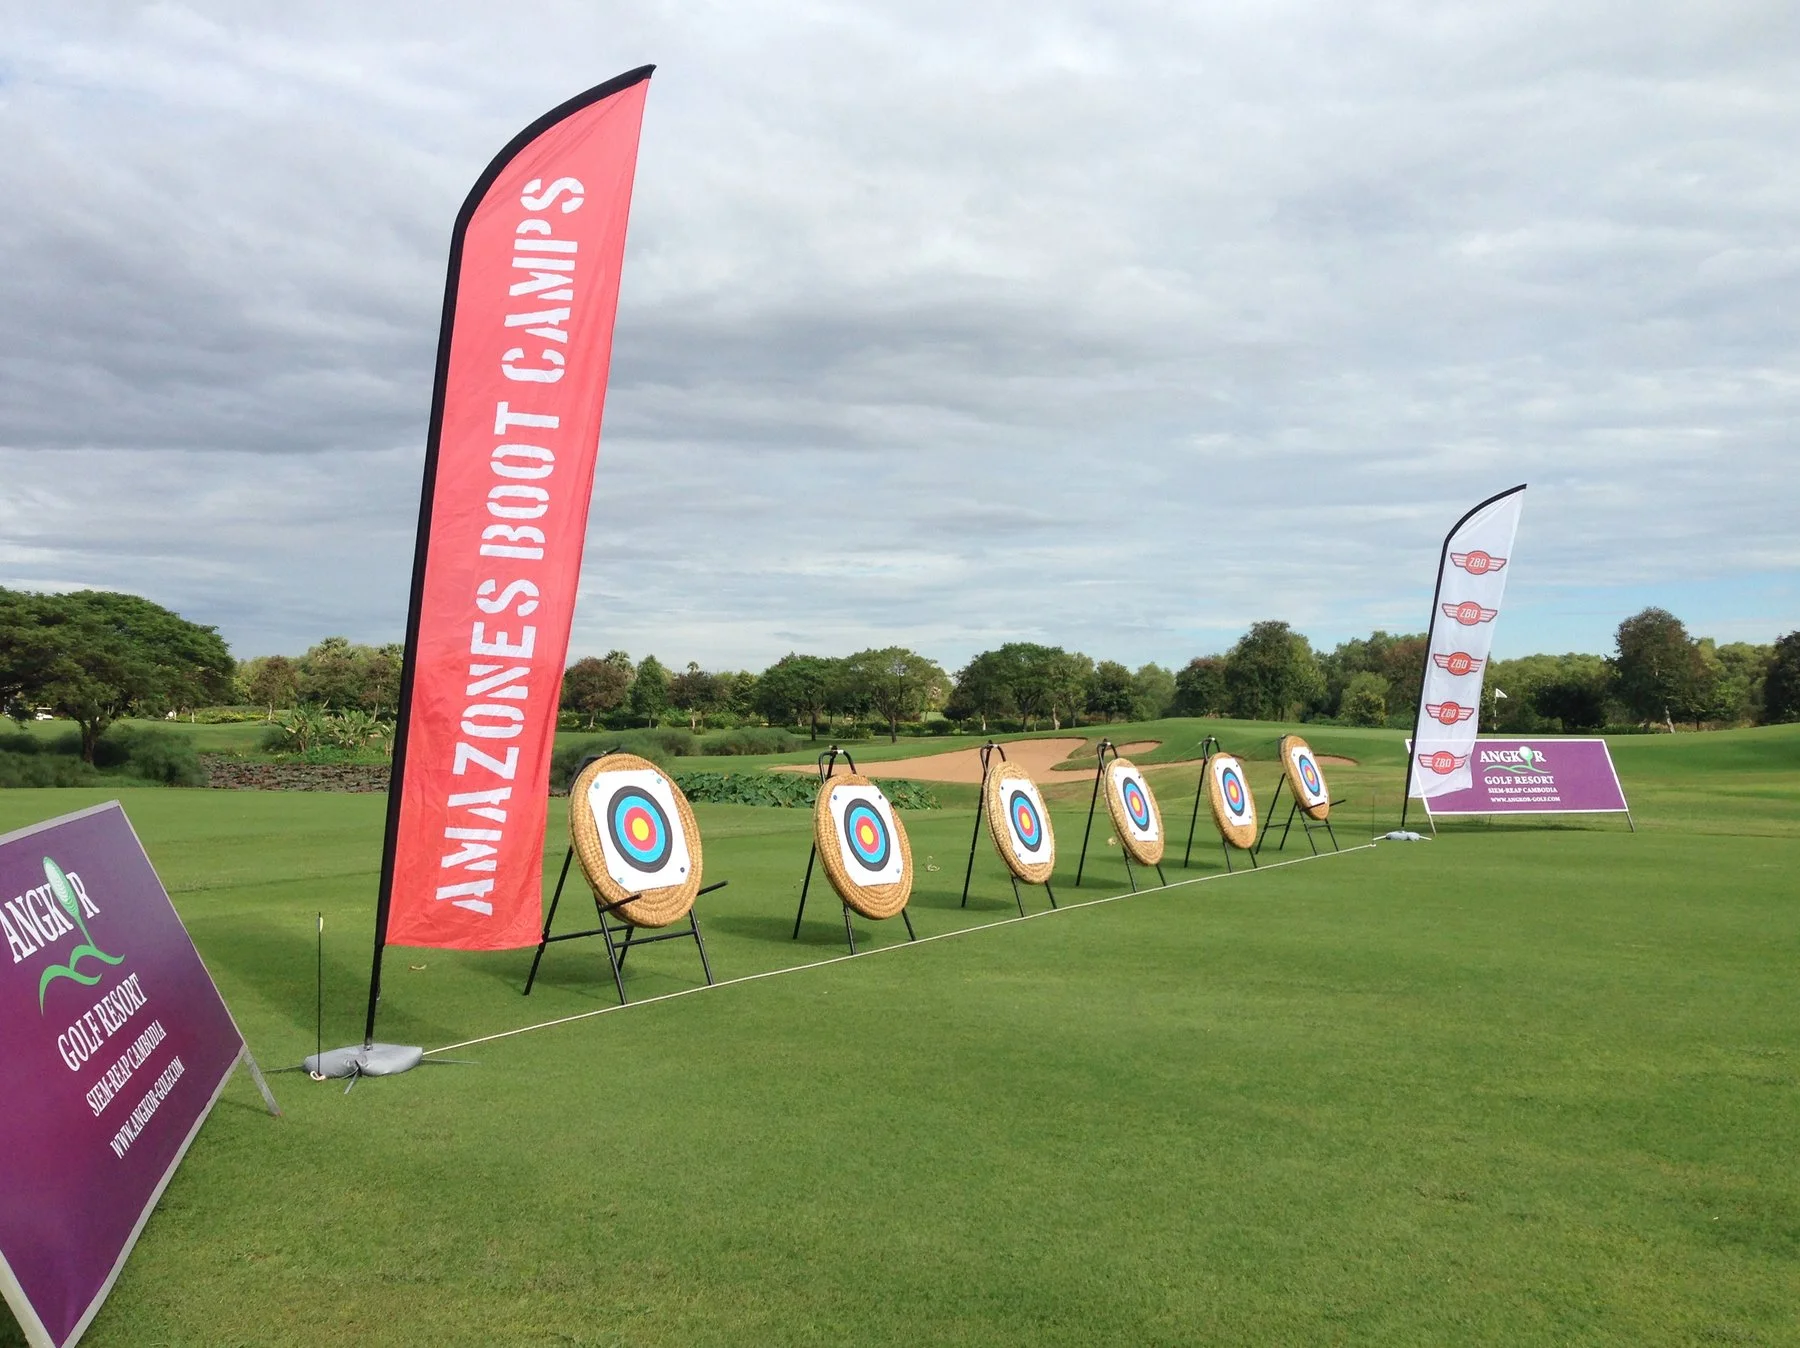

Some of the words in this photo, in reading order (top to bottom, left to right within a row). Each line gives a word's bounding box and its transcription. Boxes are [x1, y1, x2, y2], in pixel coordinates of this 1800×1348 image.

[501, 176, 586, 382] CAMPS
[479, 401, 560, 561] BOOT
[435, 578, 542, 917] AMAZONES
[1484, 776, 1513, 785] GOLF
[1513, 775, 1555, 785] RESORT
[57, 1010, 105, 1072] GOLF
[93, 972, 148, 1038] RESORT
[85, 1054, 133, 1118] SIEM-REAP
[126, 1019, 168, 1070] CAMBODIA
[109, 1055, 186, 1160] WWW.ANGKOR-GOLF.COM
